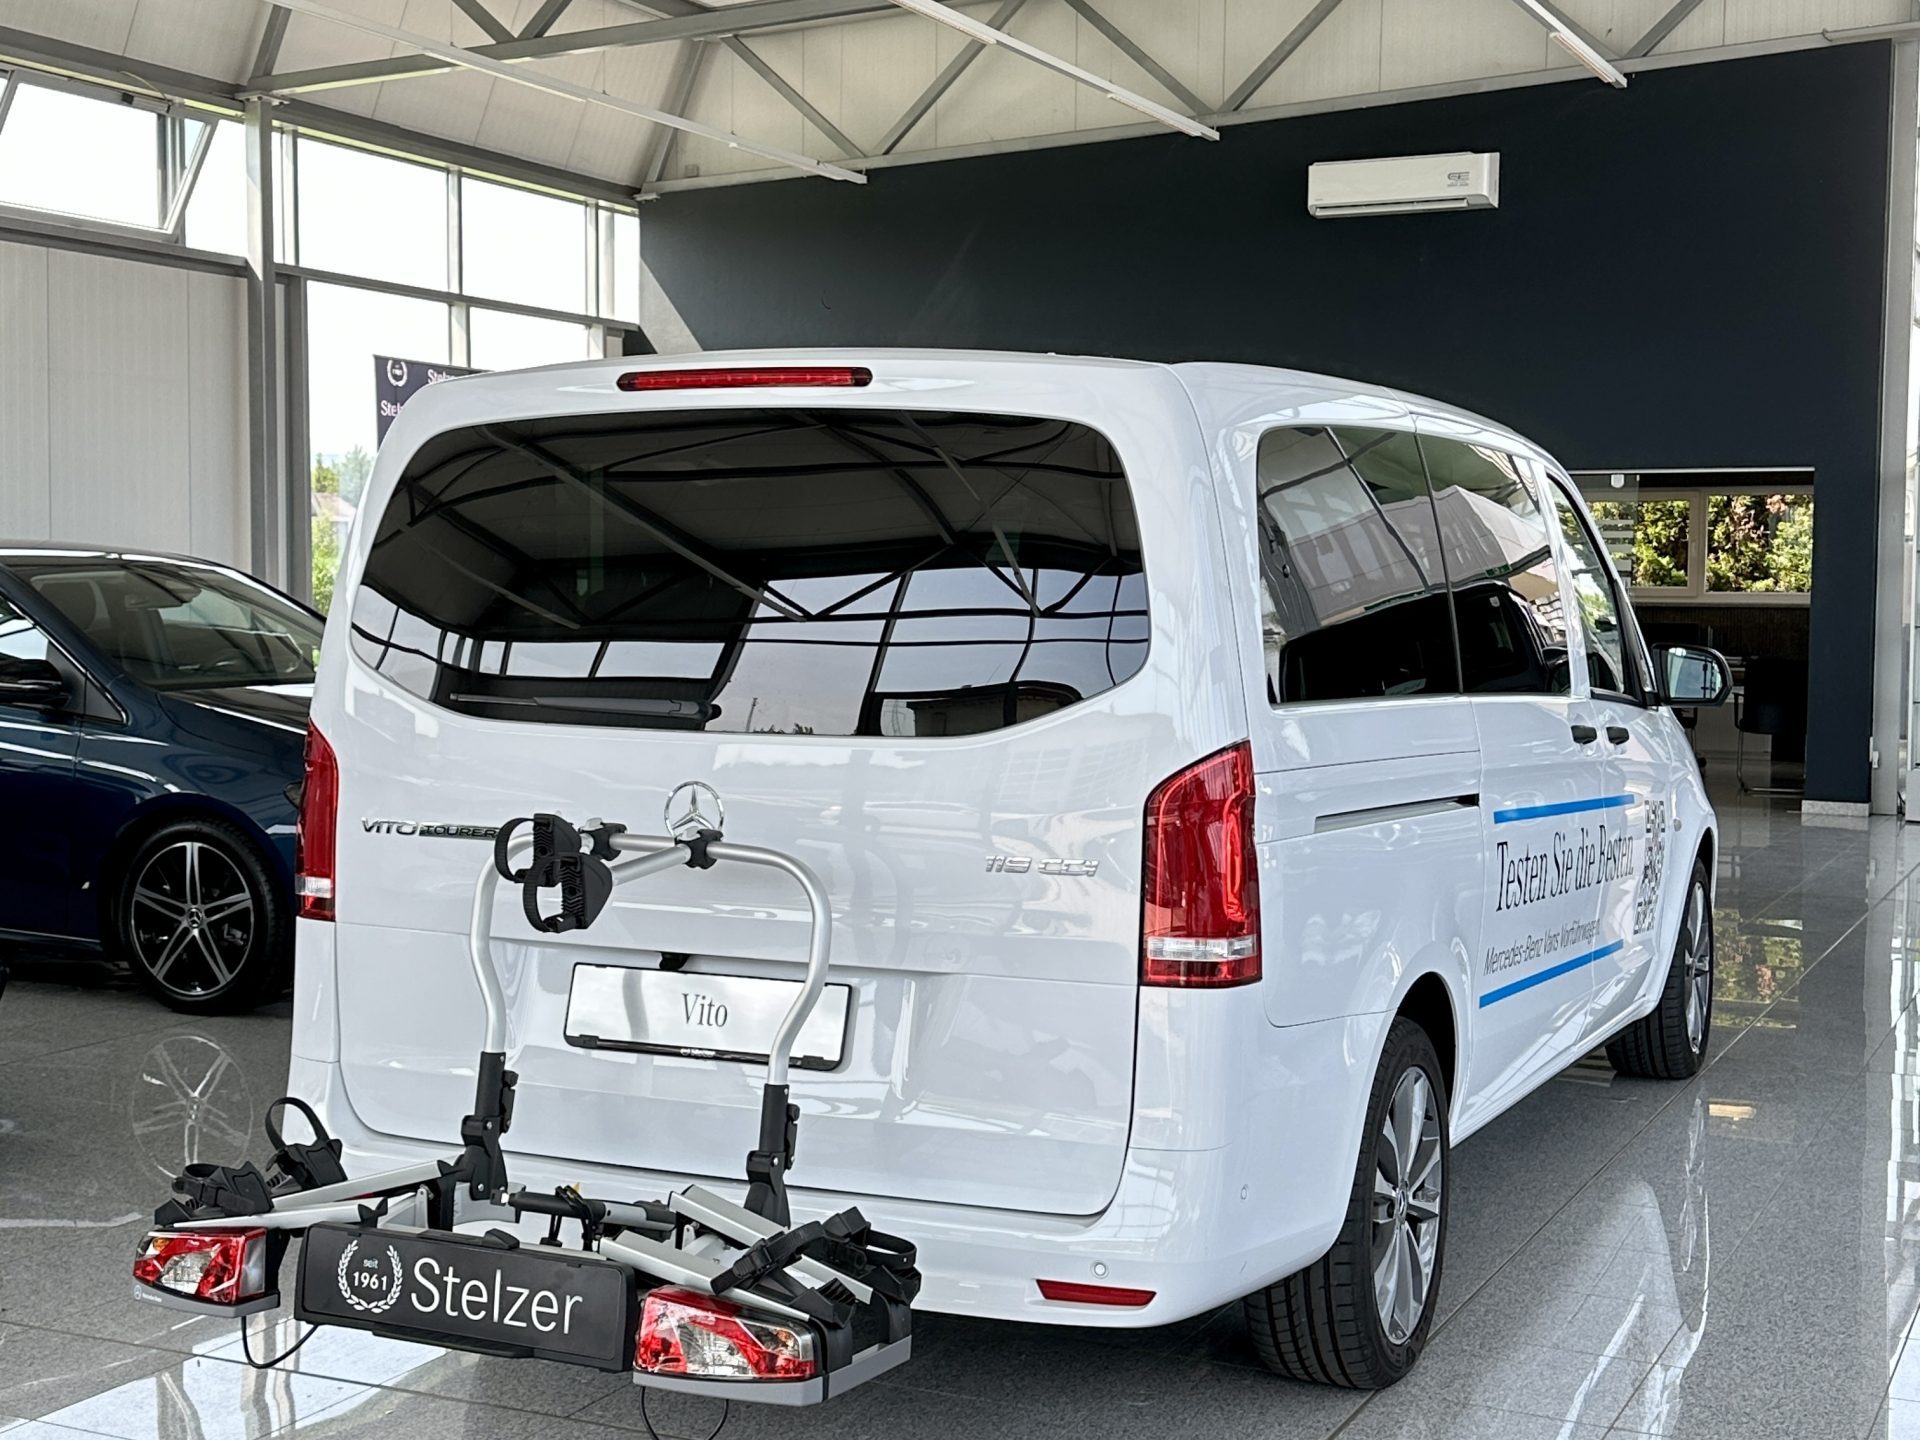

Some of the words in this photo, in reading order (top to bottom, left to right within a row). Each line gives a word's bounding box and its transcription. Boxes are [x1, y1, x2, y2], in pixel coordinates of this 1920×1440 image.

[361, 817, 418, 836] VITO
[421, 823, 499, 840] TOURER
[1495, 841, 1549, 912] Testen
[1550, 831, 1573, 898] Sie
[1575, 827, 1596, 891] die
[1483, 934, 1544, 976] Mercedes-Benz
[1543, 928, 1560, 955] Vans
[682, 992, 728, 1028] Vito
[353, 1271, 387, 1291] 1961
[363, 1258, 378, 1269] seit
[411, 1257, 583, 1334] Stelzer
